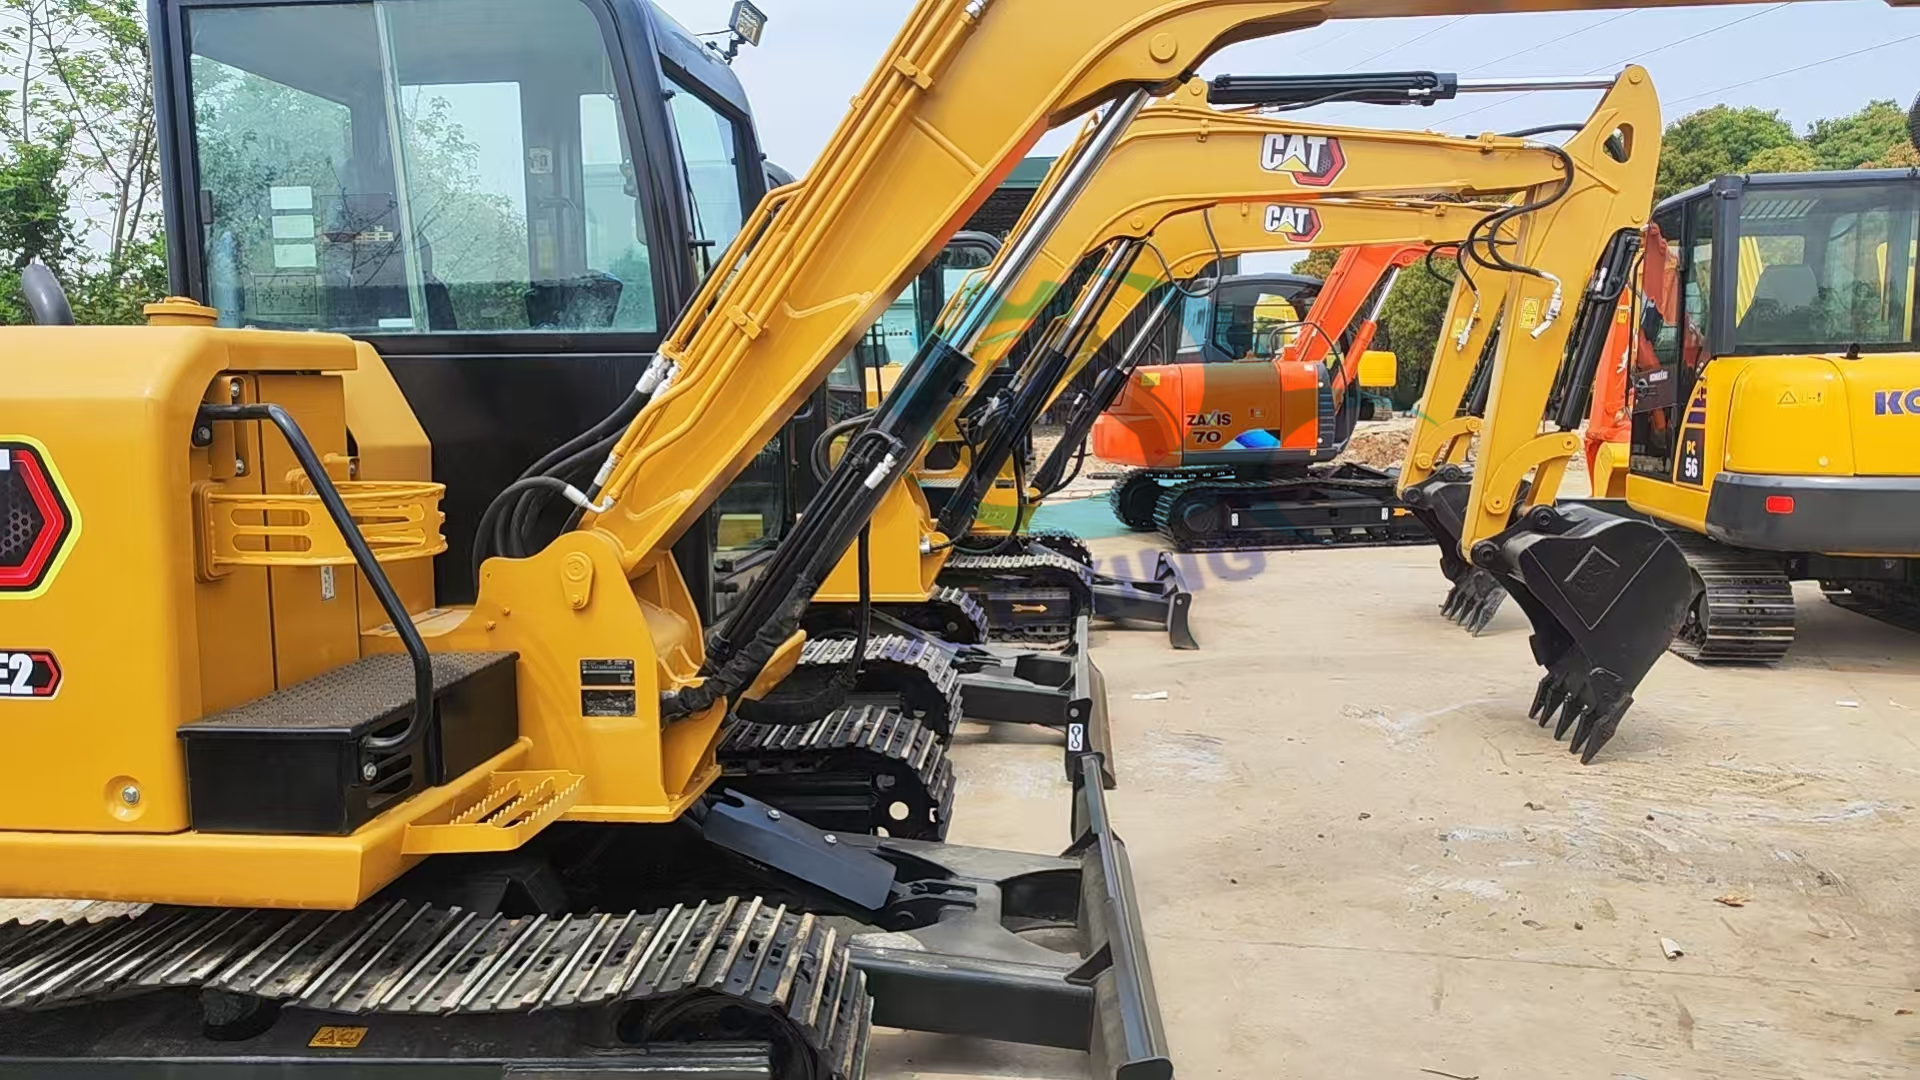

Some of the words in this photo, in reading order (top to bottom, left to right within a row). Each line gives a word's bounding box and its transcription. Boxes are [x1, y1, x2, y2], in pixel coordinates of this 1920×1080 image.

[1261, 134, 1327, 173] CAT
[1265, 205, 1309, 234] CAT
[1187, 410, 1231, 426] ZAXIS
[1193, 431, 1221, 443] 70
[1687, 440, 1696, 455] PC
[1685, 457, 1698, 478] 56
